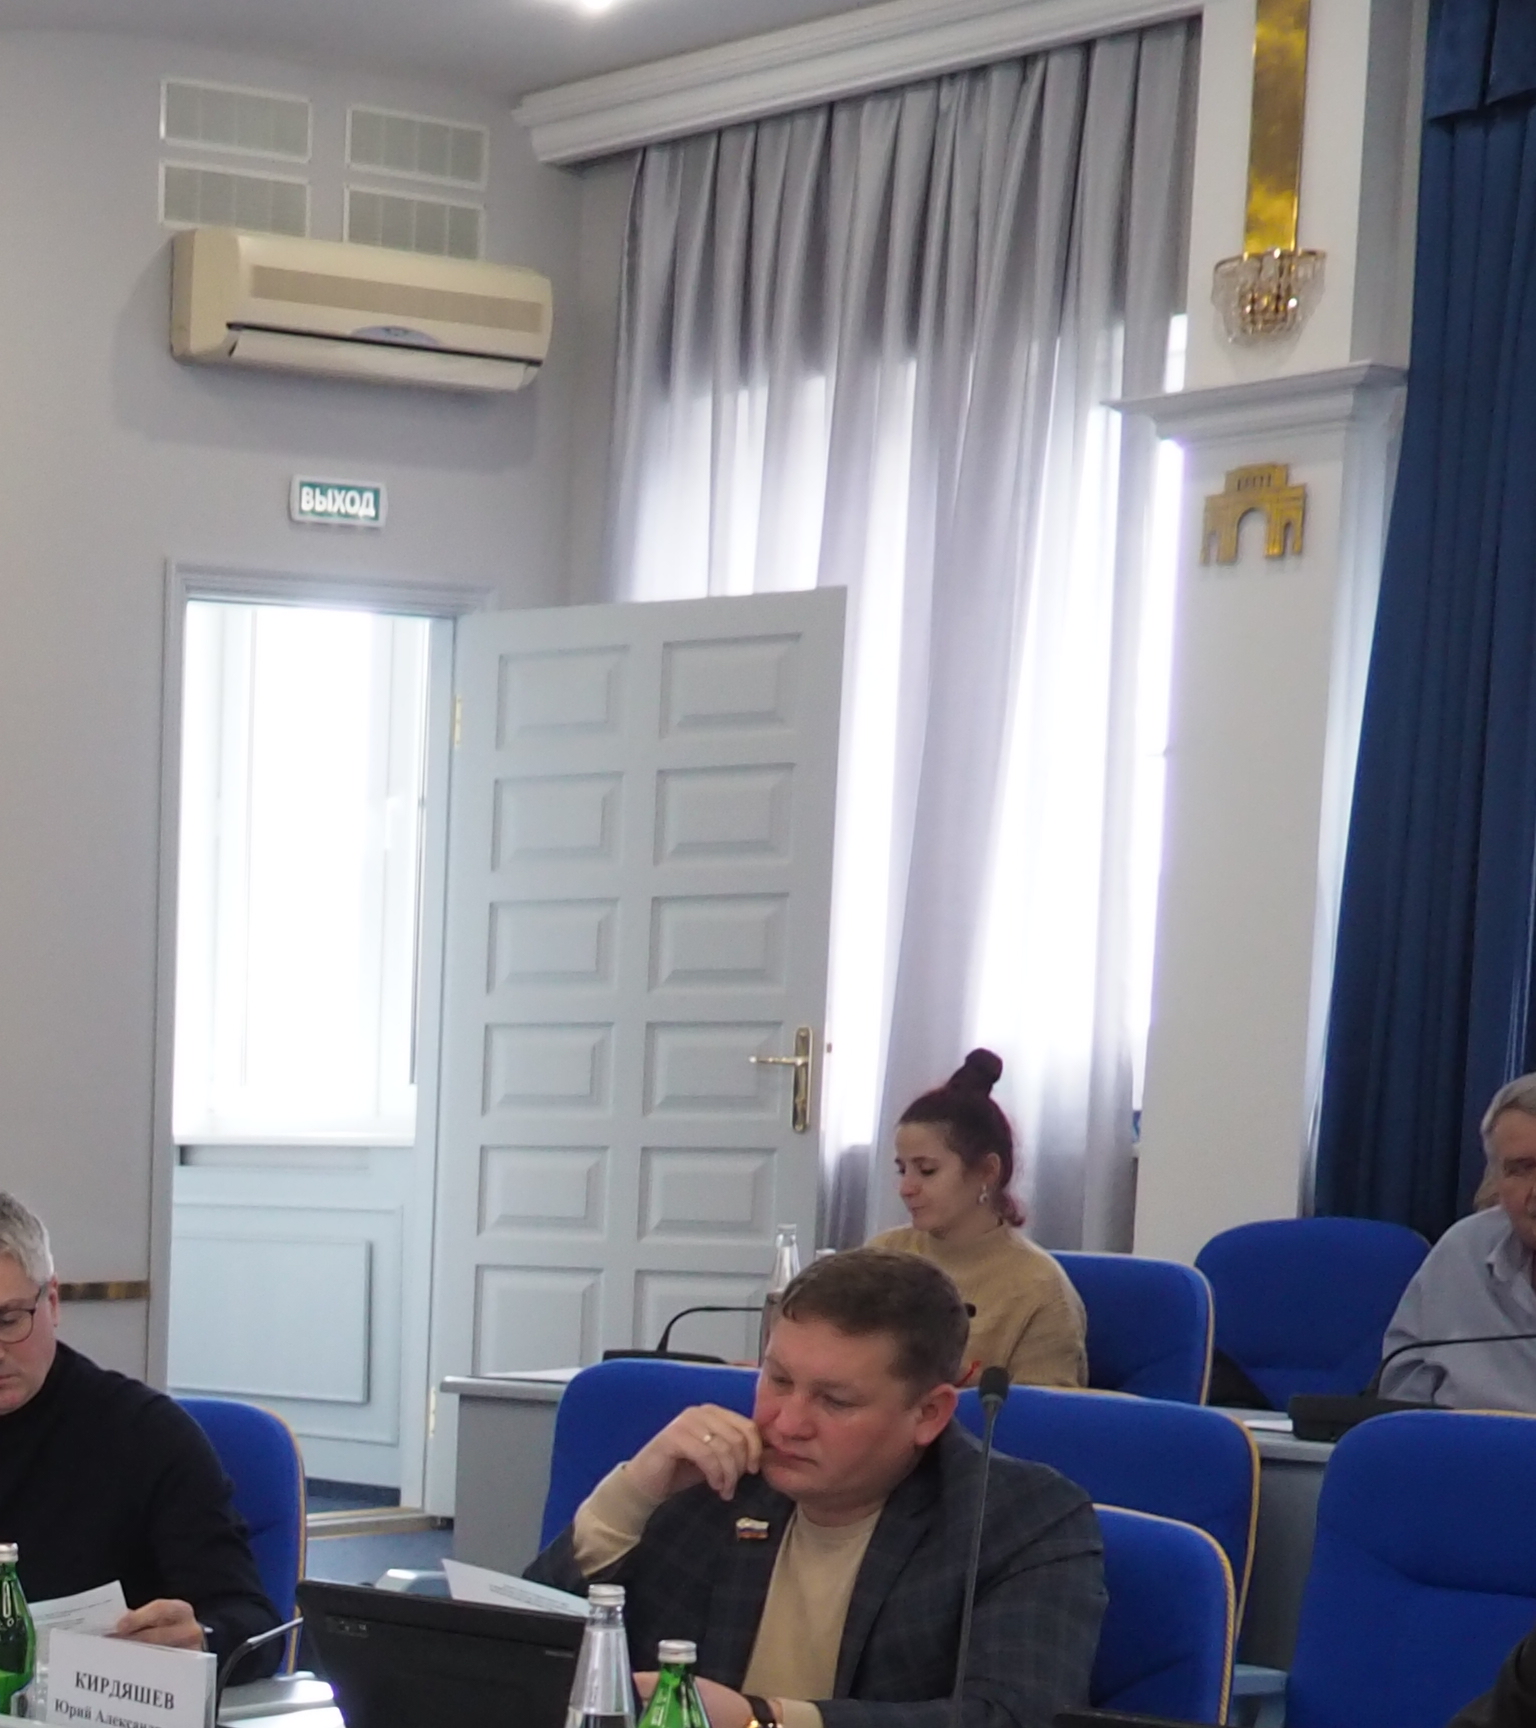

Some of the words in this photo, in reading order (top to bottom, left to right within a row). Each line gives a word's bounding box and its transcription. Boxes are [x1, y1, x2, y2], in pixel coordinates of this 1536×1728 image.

[301, 486, 375, 518] ВЫХОД
[75, 1671, 174, 1710] КИРДЯШЕВ
[55, 1698, 92, 1720] Юрий
